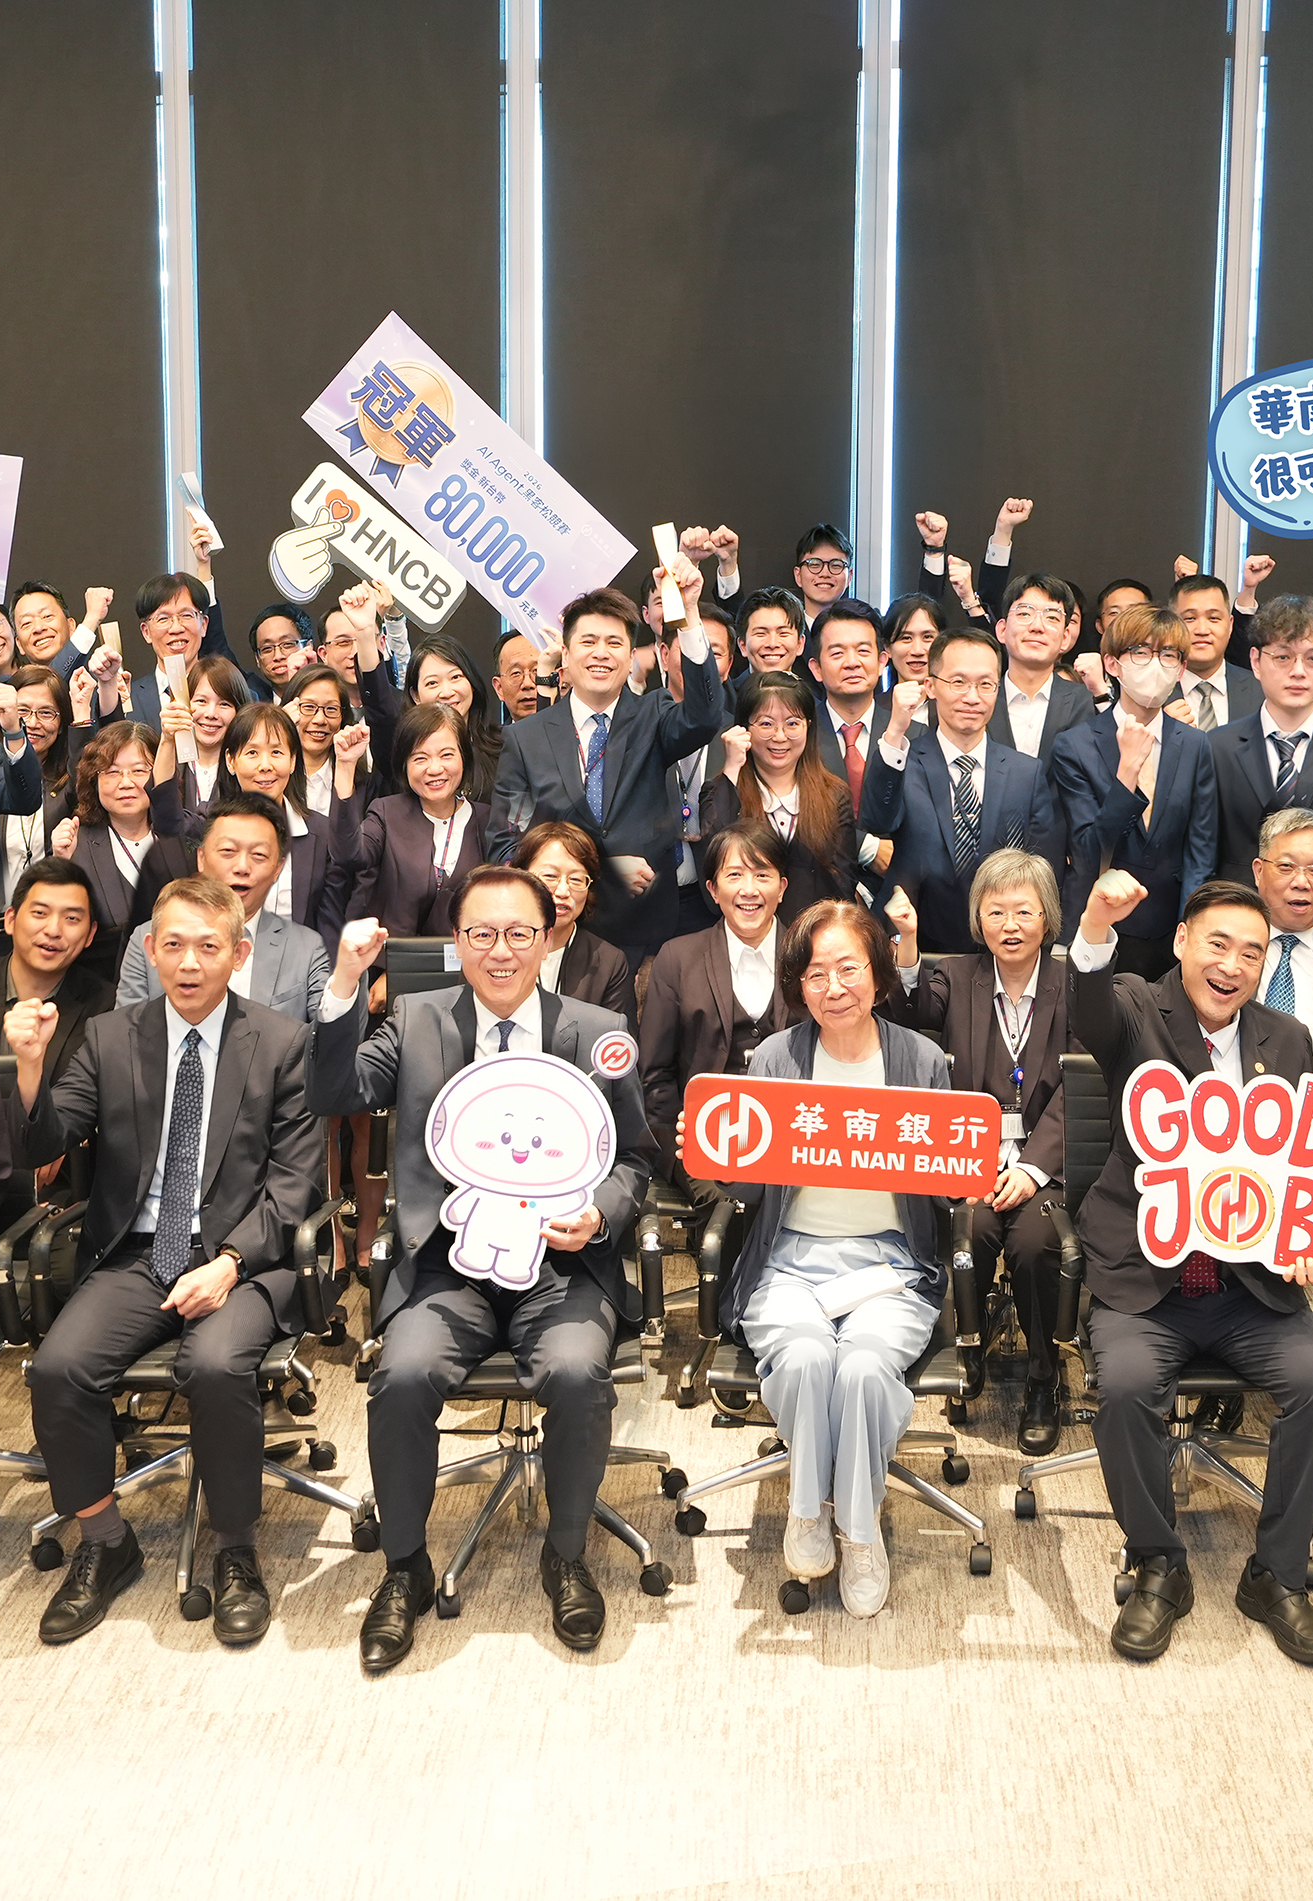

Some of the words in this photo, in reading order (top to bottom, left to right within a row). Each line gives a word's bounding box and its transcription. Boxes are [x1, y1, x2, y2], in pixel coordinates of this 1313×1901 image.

[350, 360, 457, 470] 冠軍
[523, 470, 543, 490] 2026
[350, 517, 452, 613] HNCB
[424, 473, 545, 600] 80,000
[790, 1102, 988, 1150] 華南銀行
[791, 1145, 845, 1168] HUA
[850, 1149, 906, 1172] NAN
[914, 1154, 983, 1177] BANK
